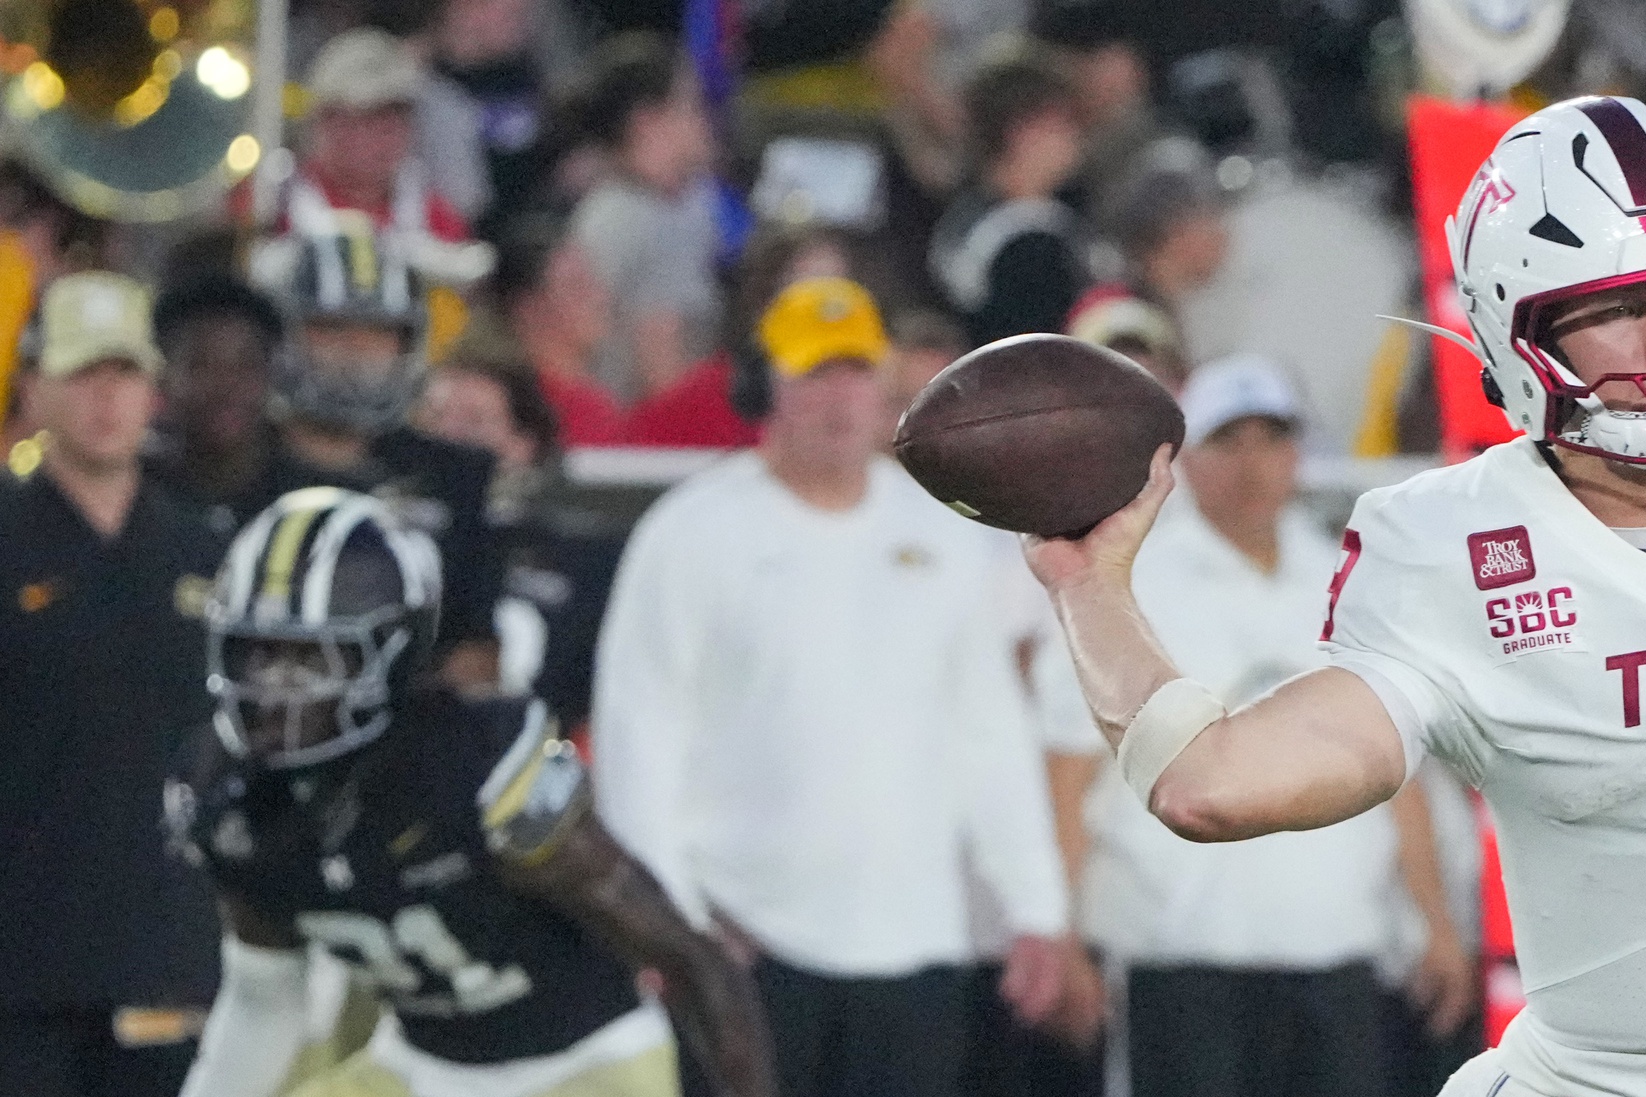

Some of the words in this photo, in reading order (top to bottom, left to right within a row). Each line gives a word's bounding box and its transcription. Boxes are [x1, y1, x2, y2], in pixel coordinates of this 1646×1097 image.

[1482, 539, 1519, 555] TROY
[1485, 549, 1526, 567] BANK
[1485, 586, 1577, 639] SBC
[1503, 632, 1572, 655] GRADUATE
